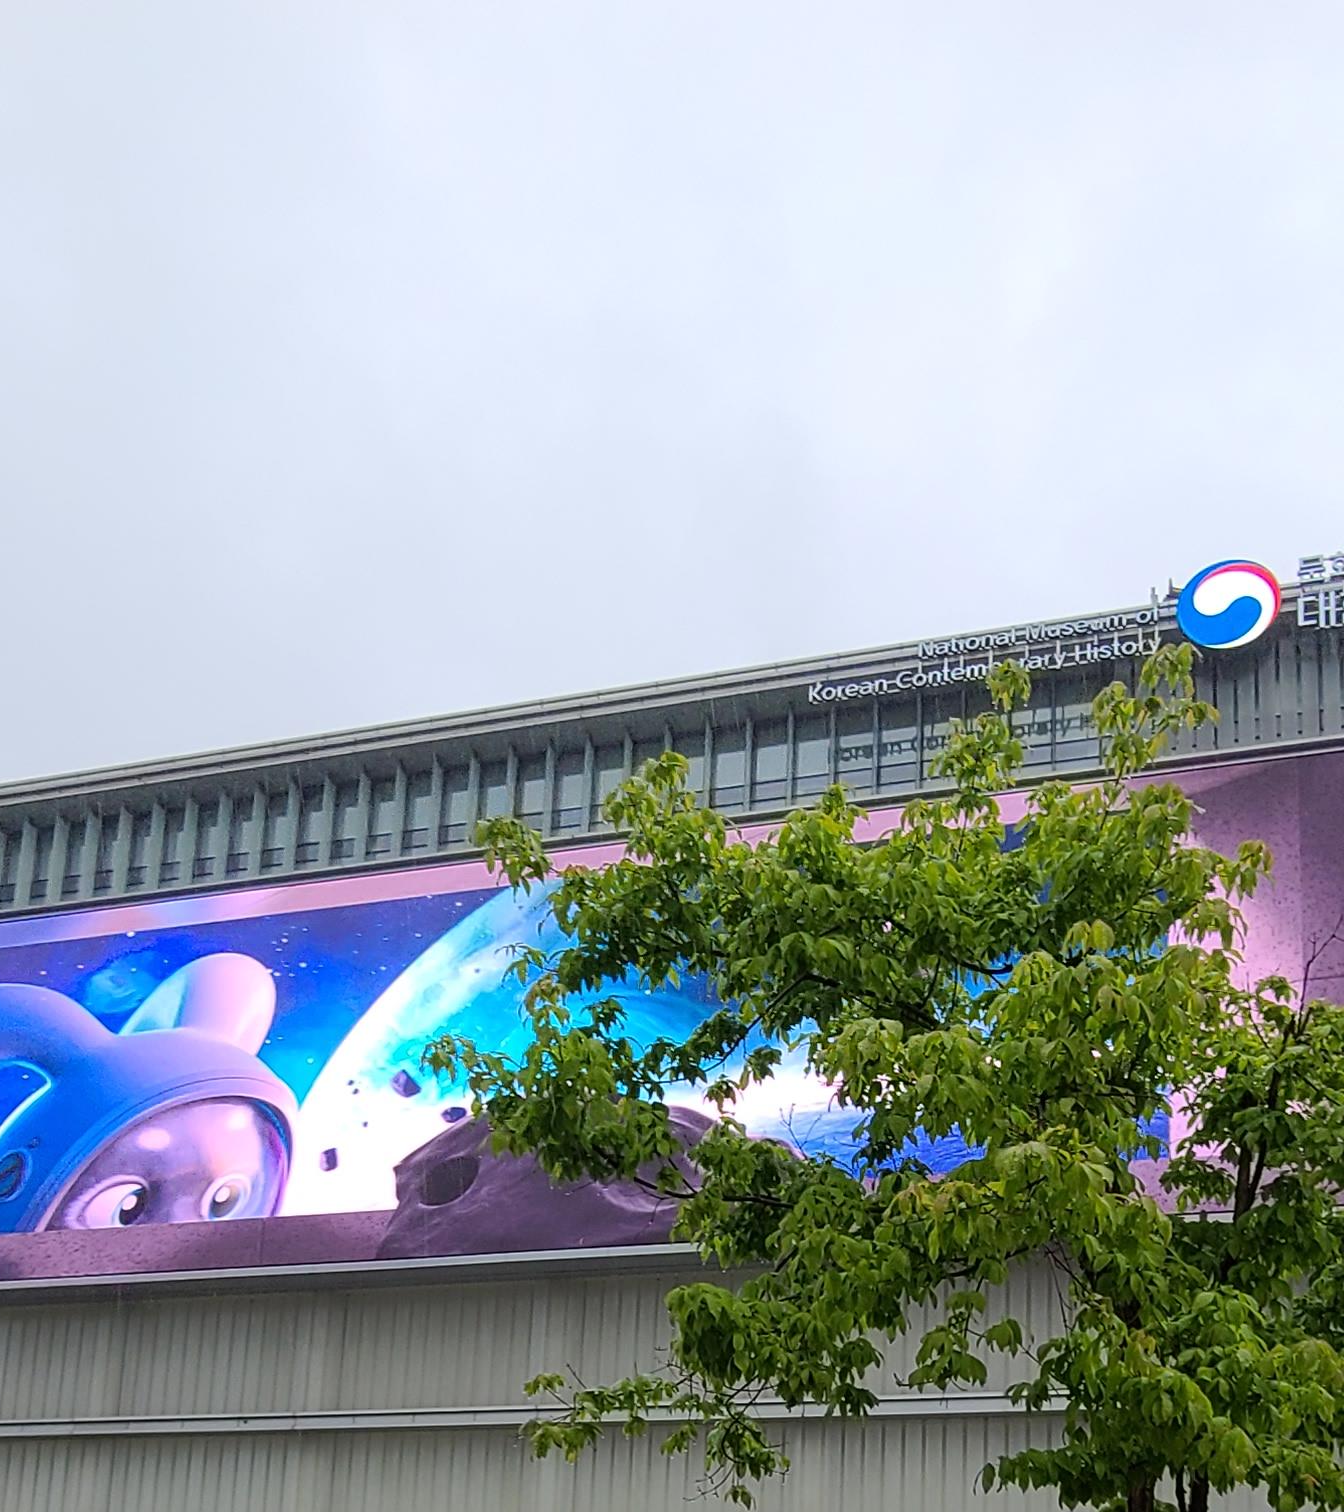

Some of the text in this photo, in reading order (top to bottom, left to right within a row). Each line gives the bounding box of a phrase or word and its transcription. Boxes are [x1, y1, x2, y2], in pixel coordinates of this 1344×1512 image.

[917, 626, 1016, 658] National
[1025, 611, 1127, 640] Museum
[808, 635, 1162, 703] Korean Contemrary History
